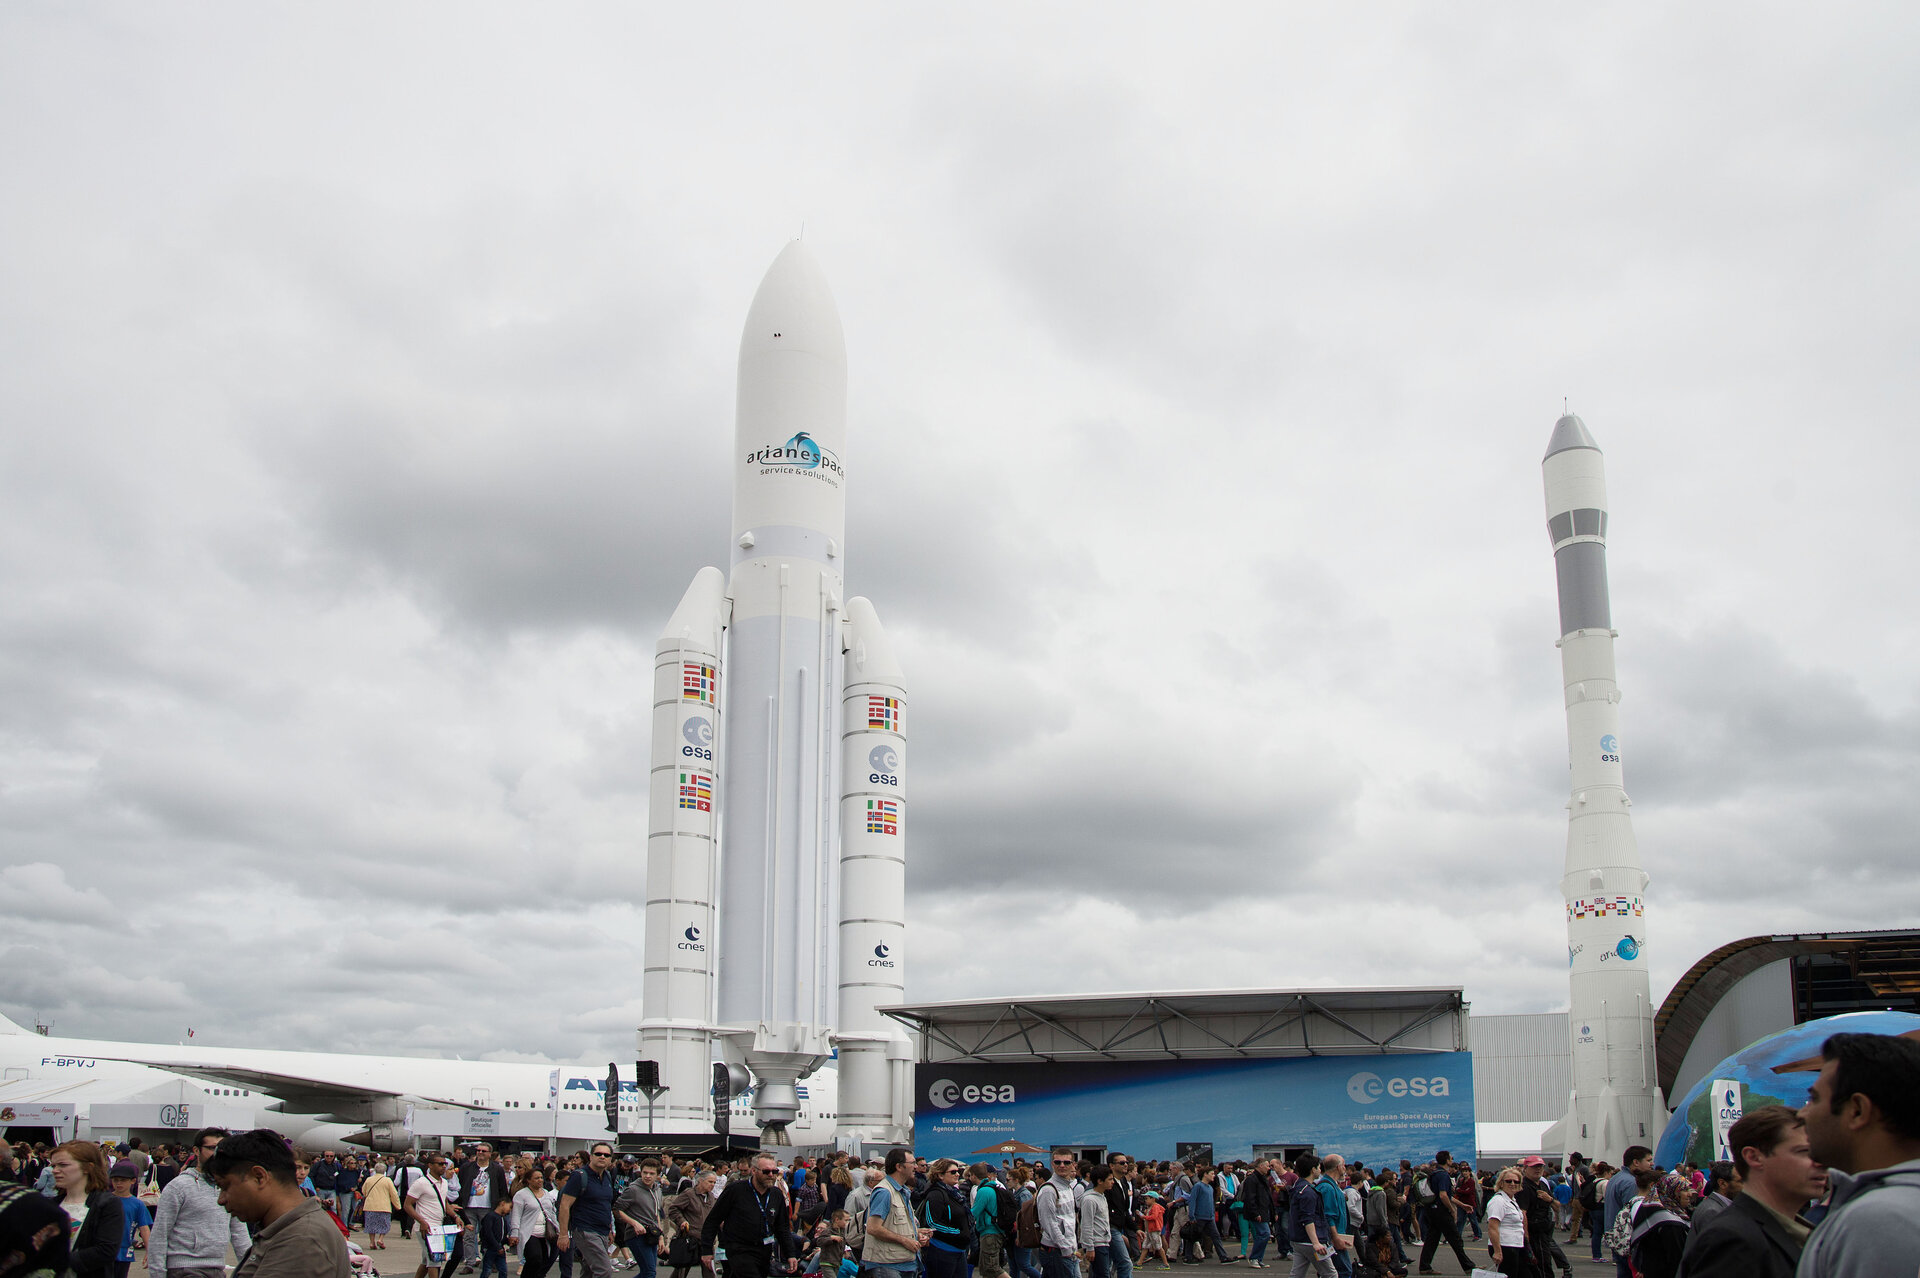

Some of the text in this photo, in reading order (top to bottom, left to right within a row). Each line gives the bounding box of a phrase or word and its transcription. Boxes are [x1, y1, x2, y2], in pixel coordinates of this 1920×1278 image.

[760, 467, 793, 475] service
[682, 746, 711, 761] esa
[869, 773, 897, 786] esa
[677, 942, 705, 951] cnes
[868, 959, 894, 968] cnes
[41, 1058, 95, 1068] F-BPVJ
[1387, 1077, 1449, 1097] esa
[962, 1085, 1015, 1103] esa
[1720, 1108, 1743, 1119] cnes
[1409, 1121, 1451, 1129] européenne
